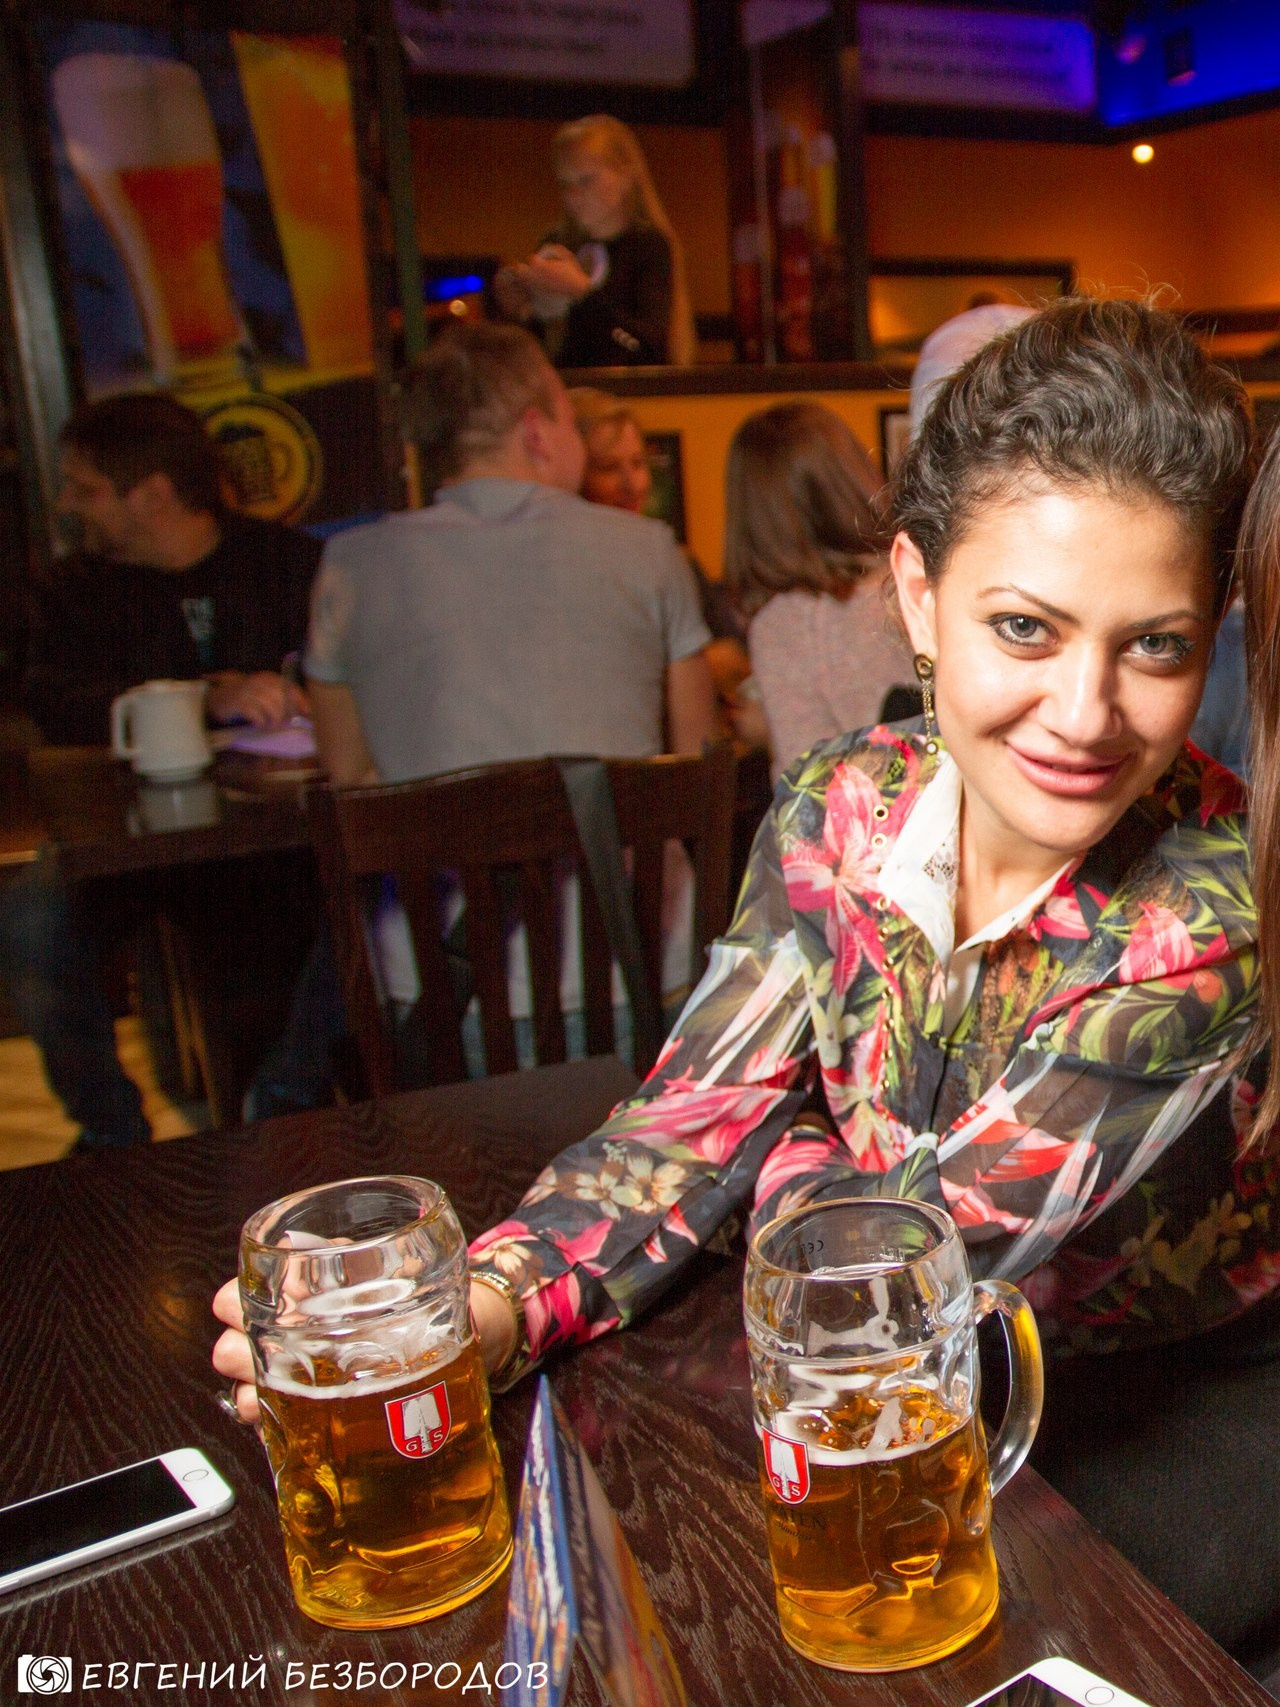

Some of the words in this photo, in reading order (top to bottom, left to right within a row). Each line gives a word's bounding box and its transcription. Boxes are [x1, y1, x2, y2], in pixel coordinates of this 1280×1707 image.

[405, 1440, 418, 1453] G
[433, 1429, 443, 1443] S
[772, 1476, 780, 1488] G
[791, 1485, 801, 1497] S
